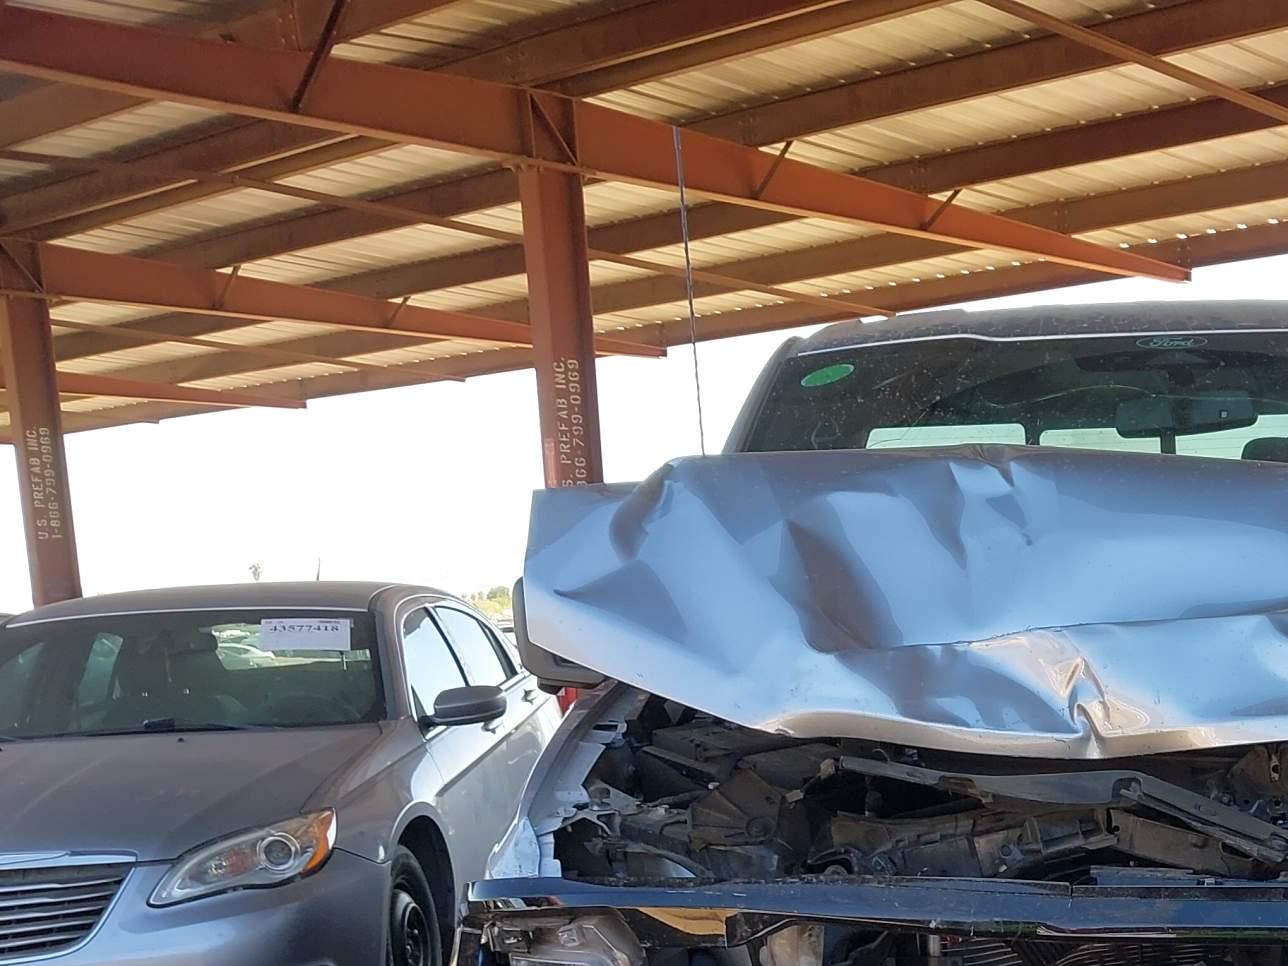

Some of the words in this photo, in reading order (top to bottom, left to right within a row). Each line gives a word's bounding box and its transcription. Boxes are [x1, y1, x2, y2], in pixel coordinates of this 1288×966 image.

[553, 357, 567, 389] INC.
[26, 426, 39, 451] INC.
[555, 398, 572, 464] PREFAB
[29, 457, 46, 508] PREFAB
[39, 427, 63, 539] 1-866-799-0969
[36, 516, 49, 540] U.S.
